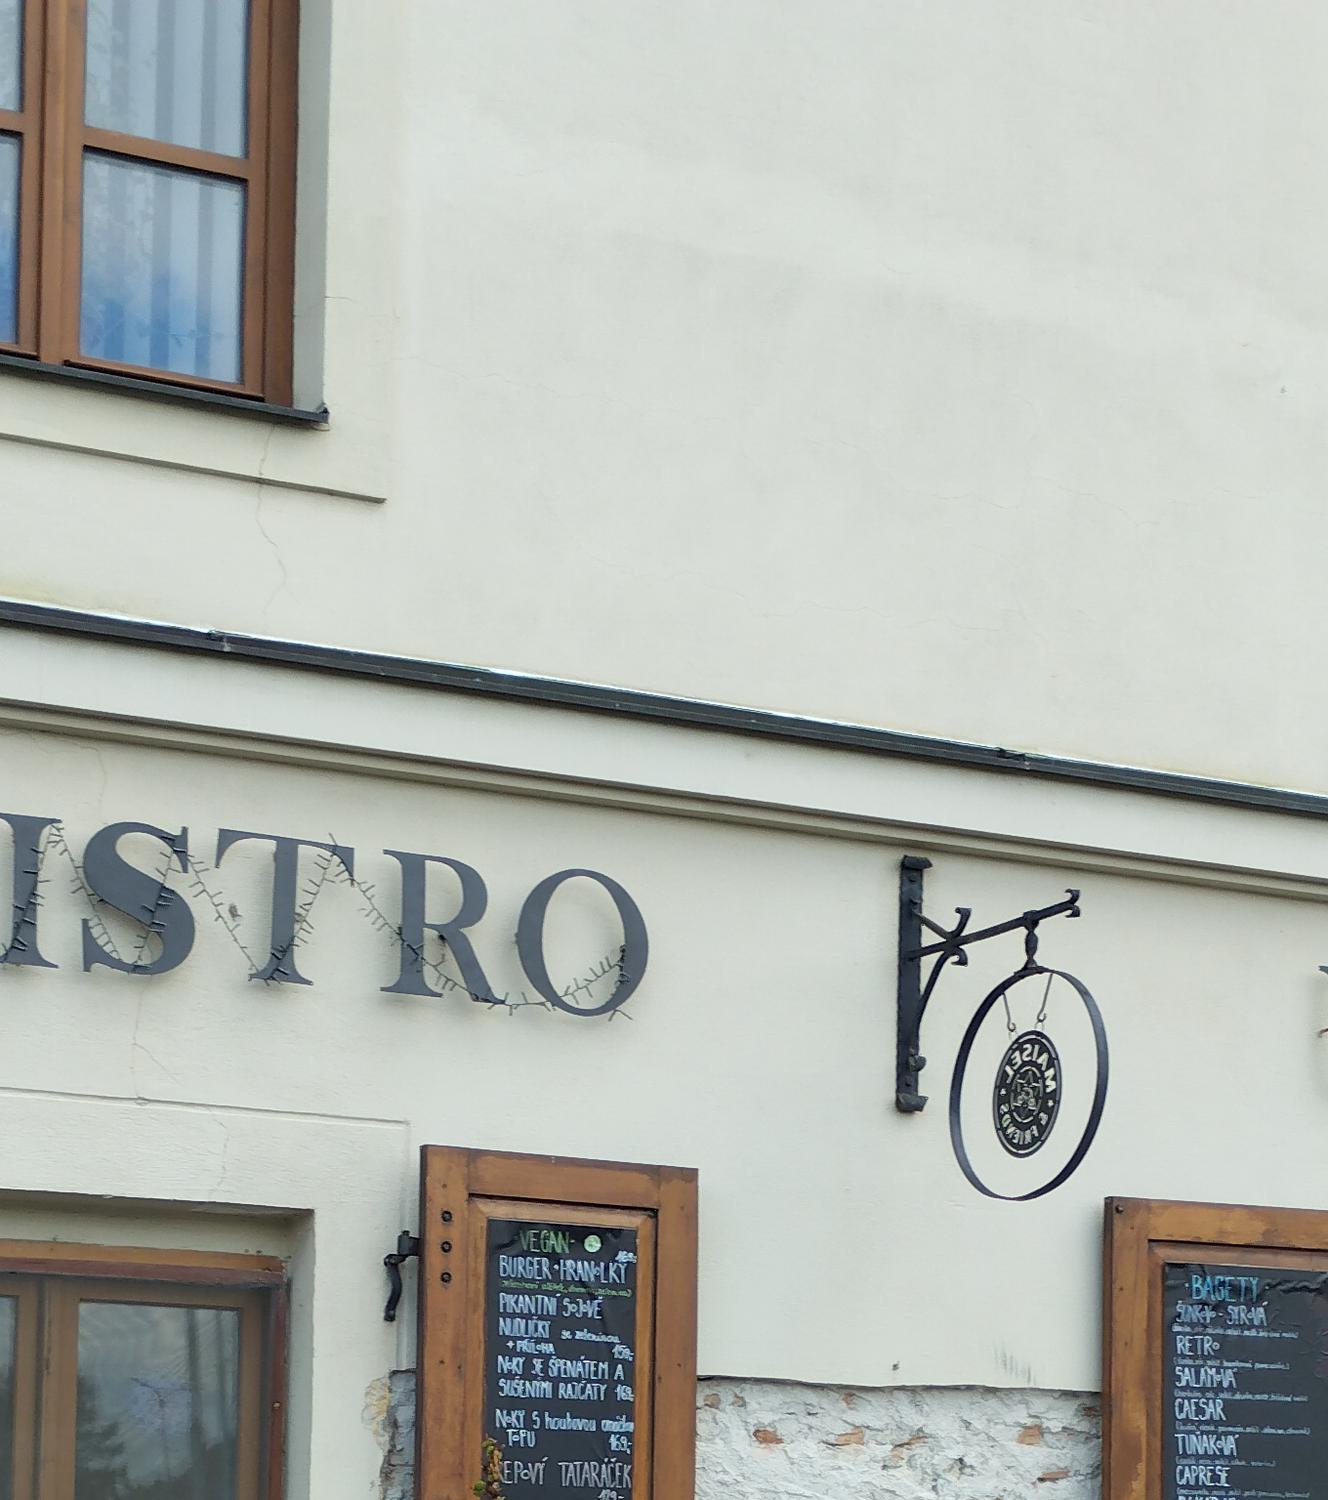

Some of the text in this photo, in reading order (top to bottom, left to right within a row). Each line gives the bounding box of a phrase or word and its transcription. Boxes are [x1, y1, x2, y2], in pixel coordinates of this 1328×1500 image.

[499, 1255, 552, 1280] BURGER
[1192, 1275, 1260, 1302] BAGETY
[499, 1293, 561, 1316] PIKANTNÍ
[548, 1355, 609, 1380] ŠPENÁTEM
[614, 1363, 625, 1380] A
[1174, 1398, 1226, 1421] CAESAR
[1176, 1466, 1231, 1487] CAPRESE
